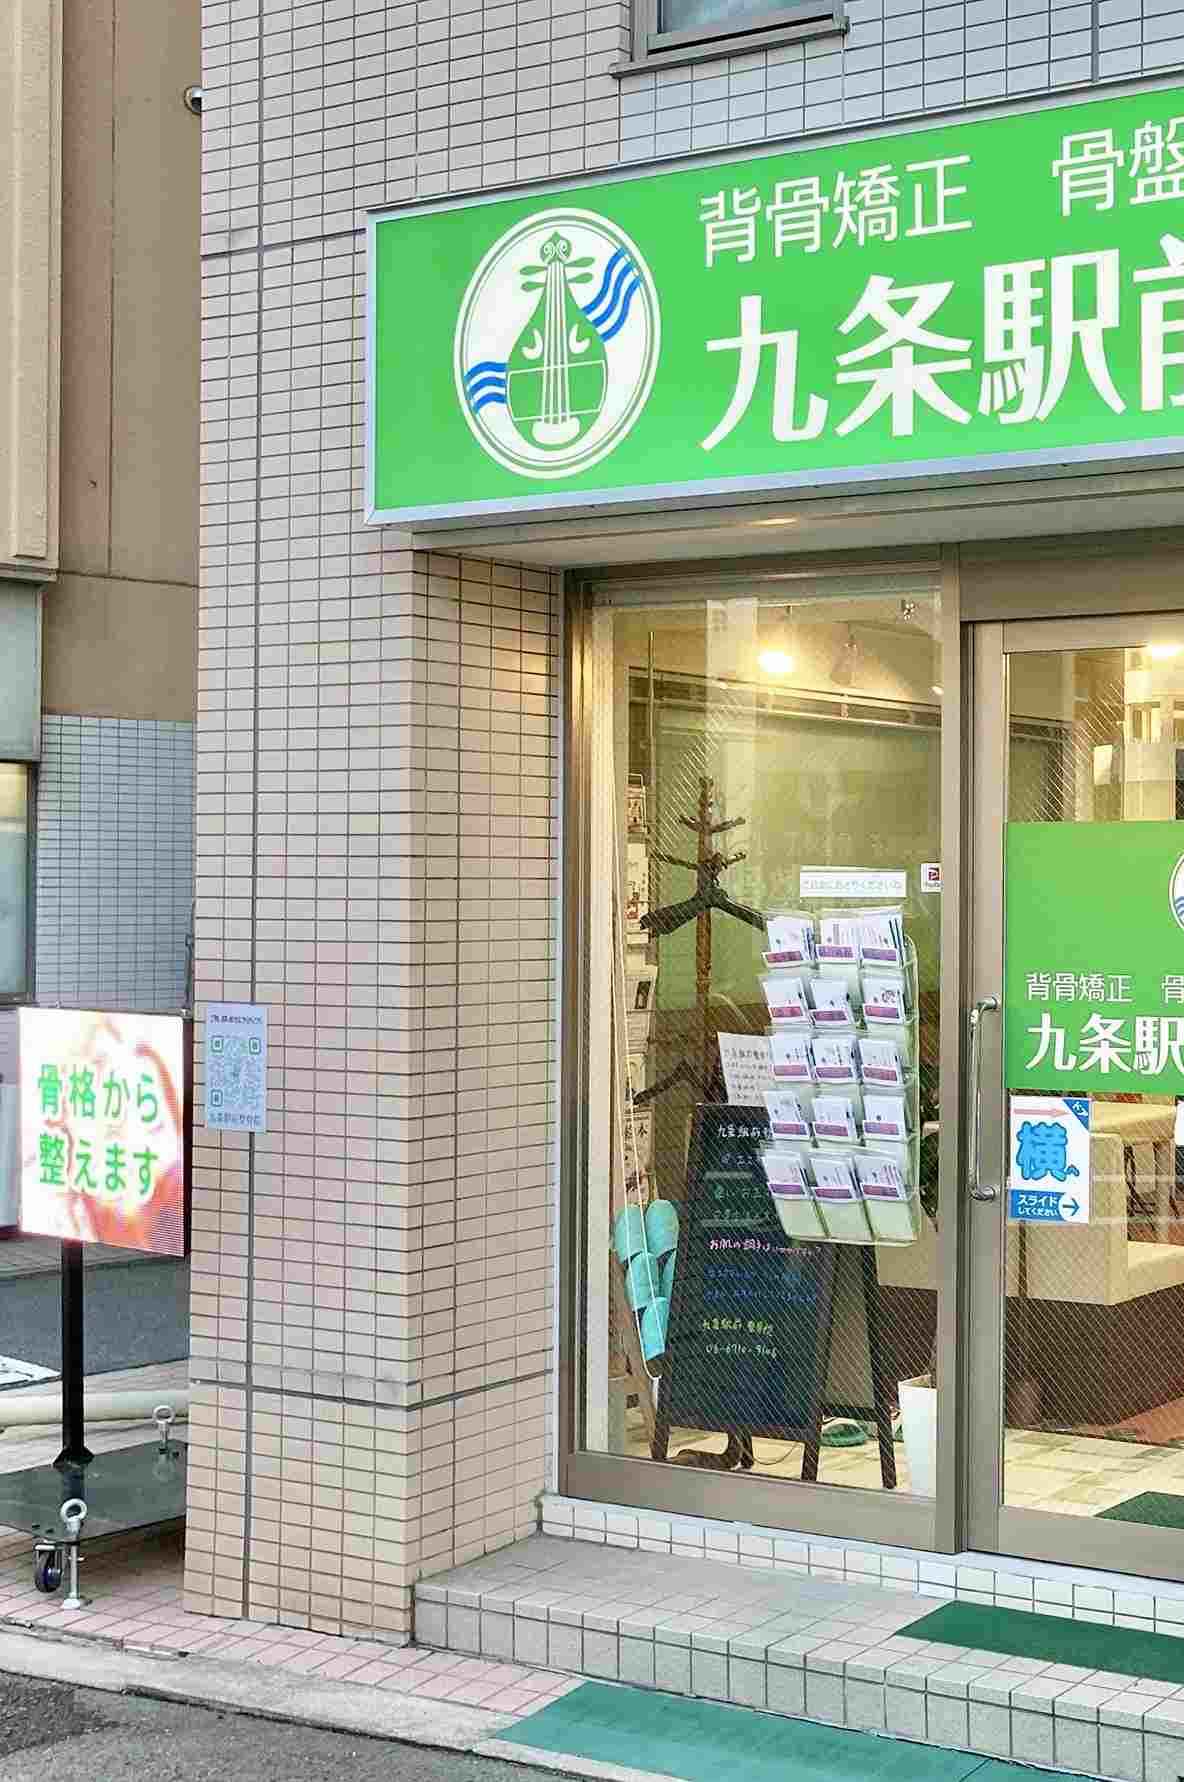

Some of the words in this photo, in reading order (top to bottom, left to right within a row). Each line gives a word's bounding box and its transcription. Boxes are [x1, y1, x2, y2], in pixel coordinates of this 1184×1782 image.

[700, 155, 973, 267] 背骨矯正
[1026, 972, 1132, 1003] 背骨矯正
[38, 1063, 158, 1123] 骨格から
[38, 1132, 159, 1195] 整えます
[1017, 1193, 1058, 1206] スライド
